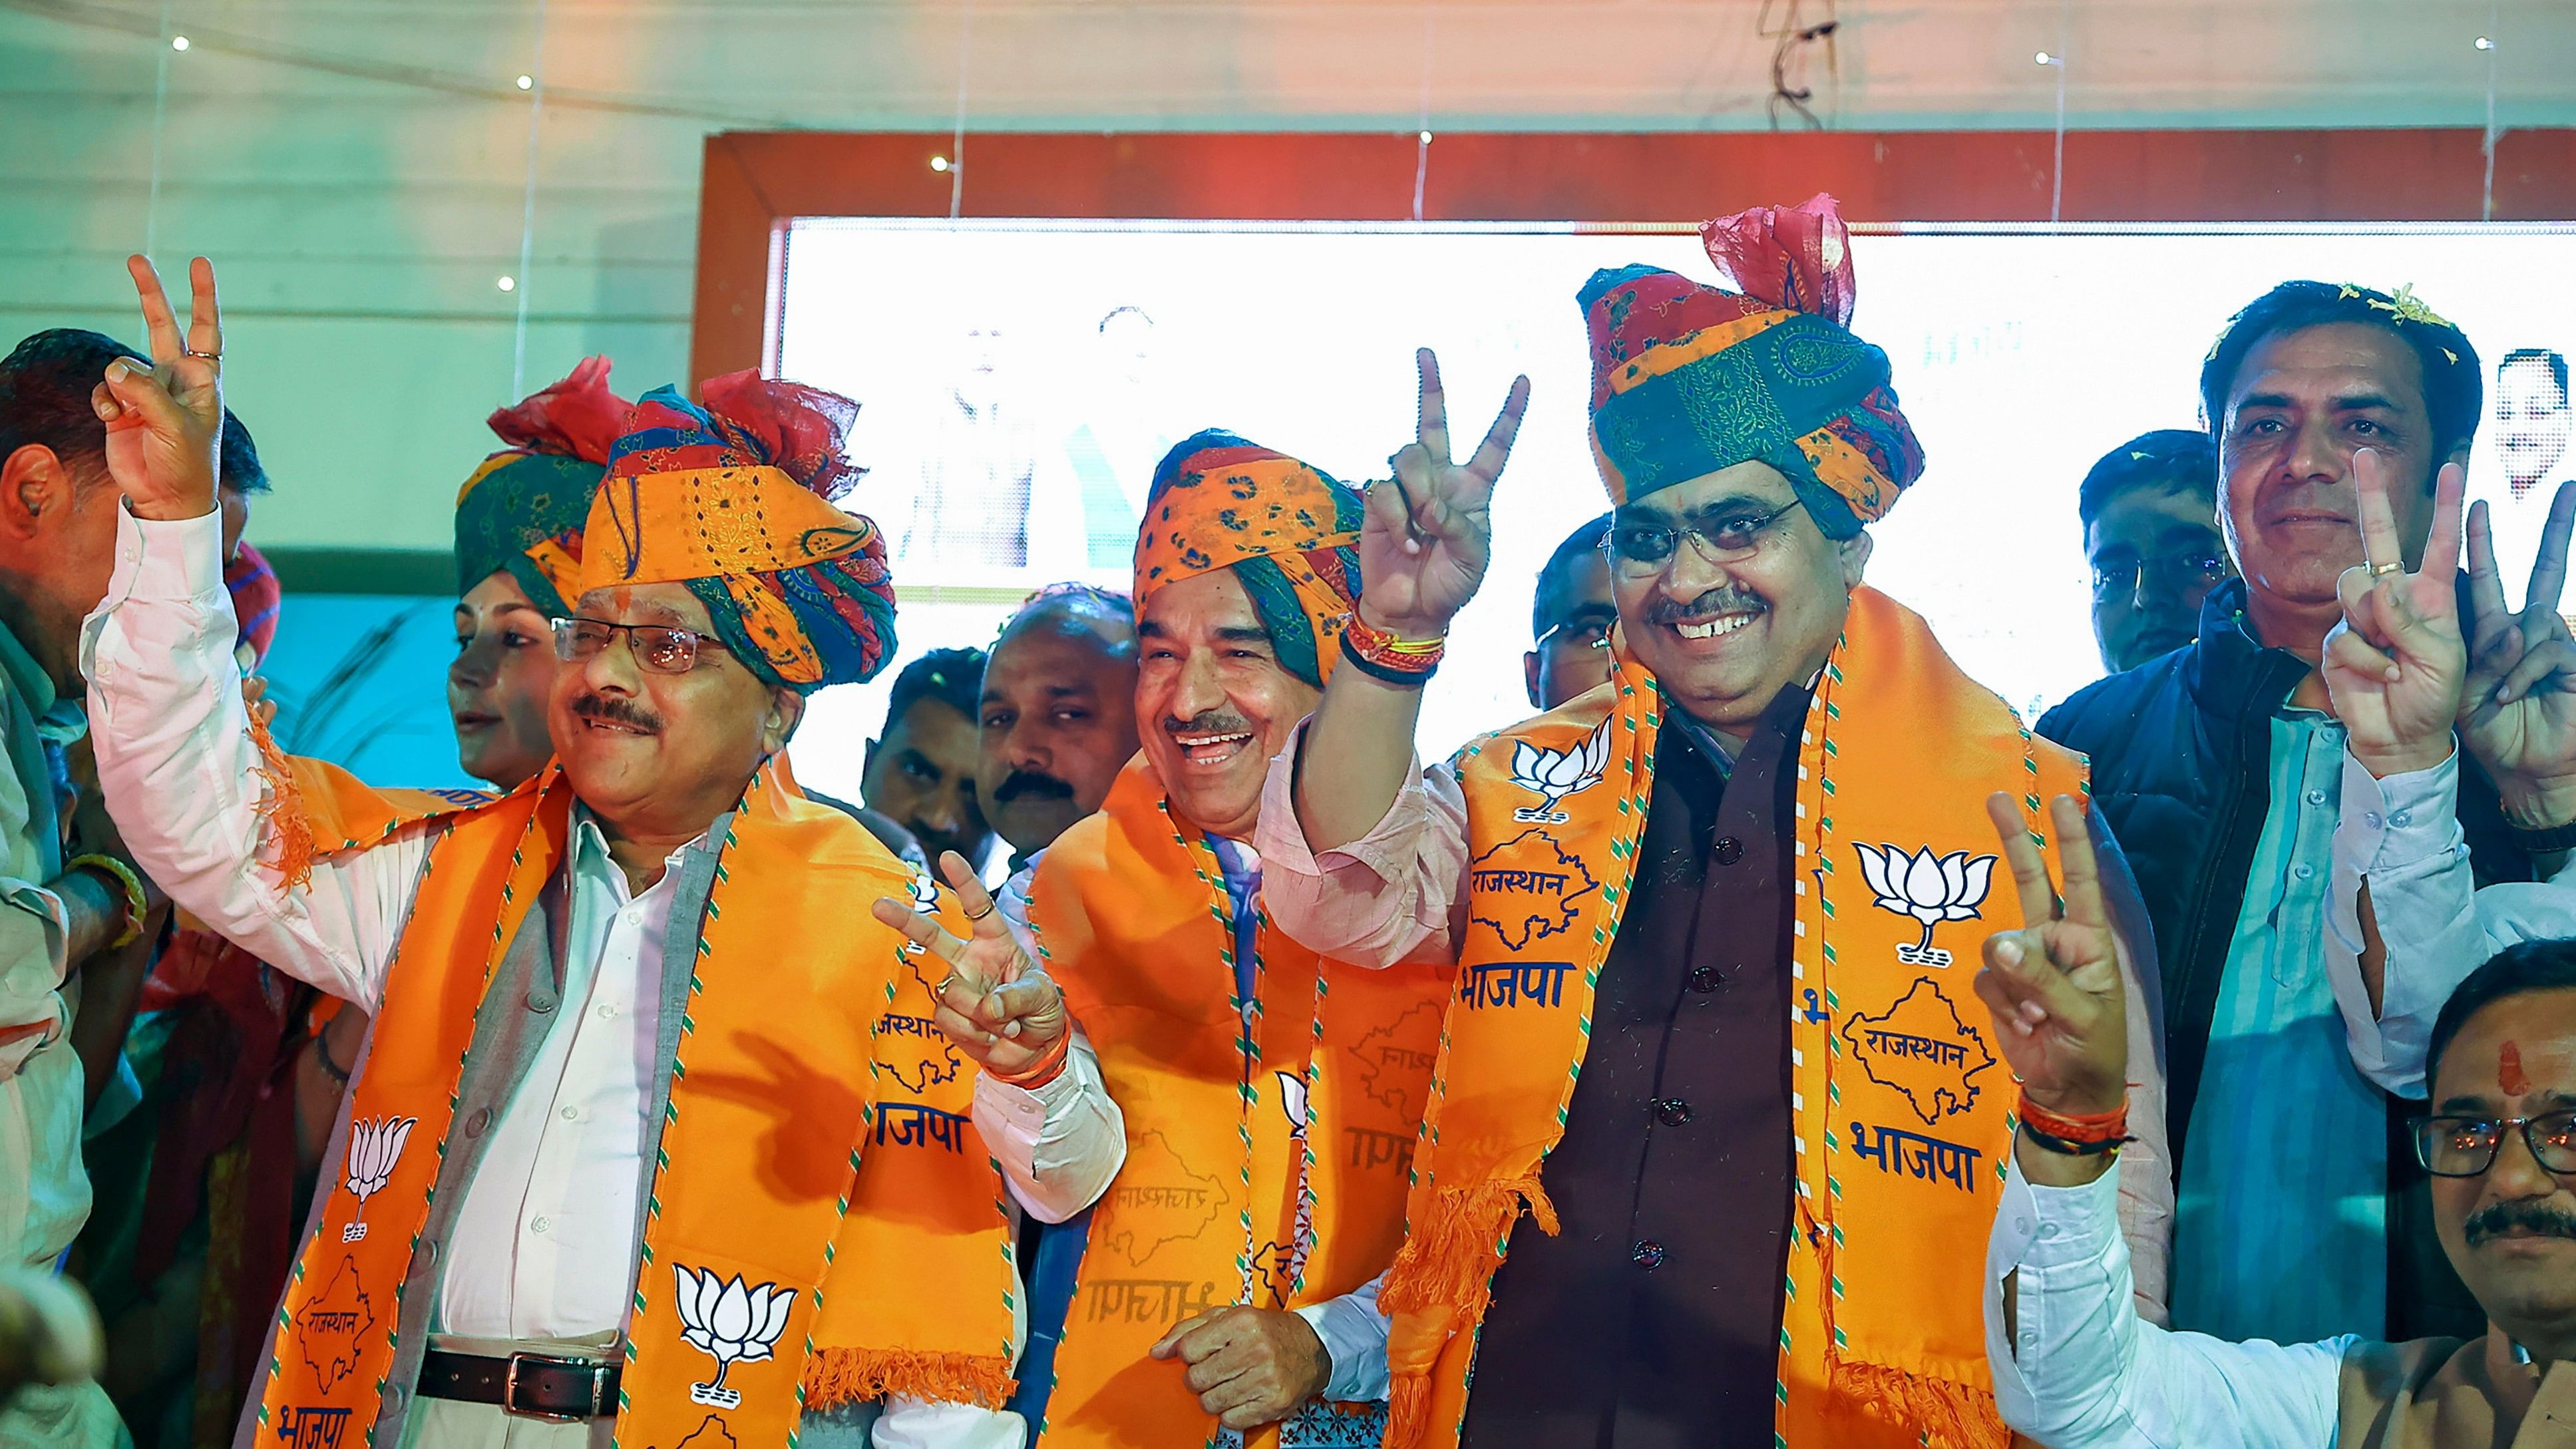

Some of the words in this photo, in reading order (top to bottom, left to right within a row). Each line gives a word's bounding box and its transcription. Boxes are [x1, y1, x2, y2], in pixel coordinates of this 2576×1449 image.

[1472, 870, 1570, 896] राजस्थान
[1461, 962, 1577, 1011] भाजपा
[1864, 1029, 1970, 1069] राजस्थान
[1850, 1122, 1982, 1193] भाजपा
[307, 1312, 359, 1335] राजस्थान
[277, 1404, 353, 1449] भाजपा
